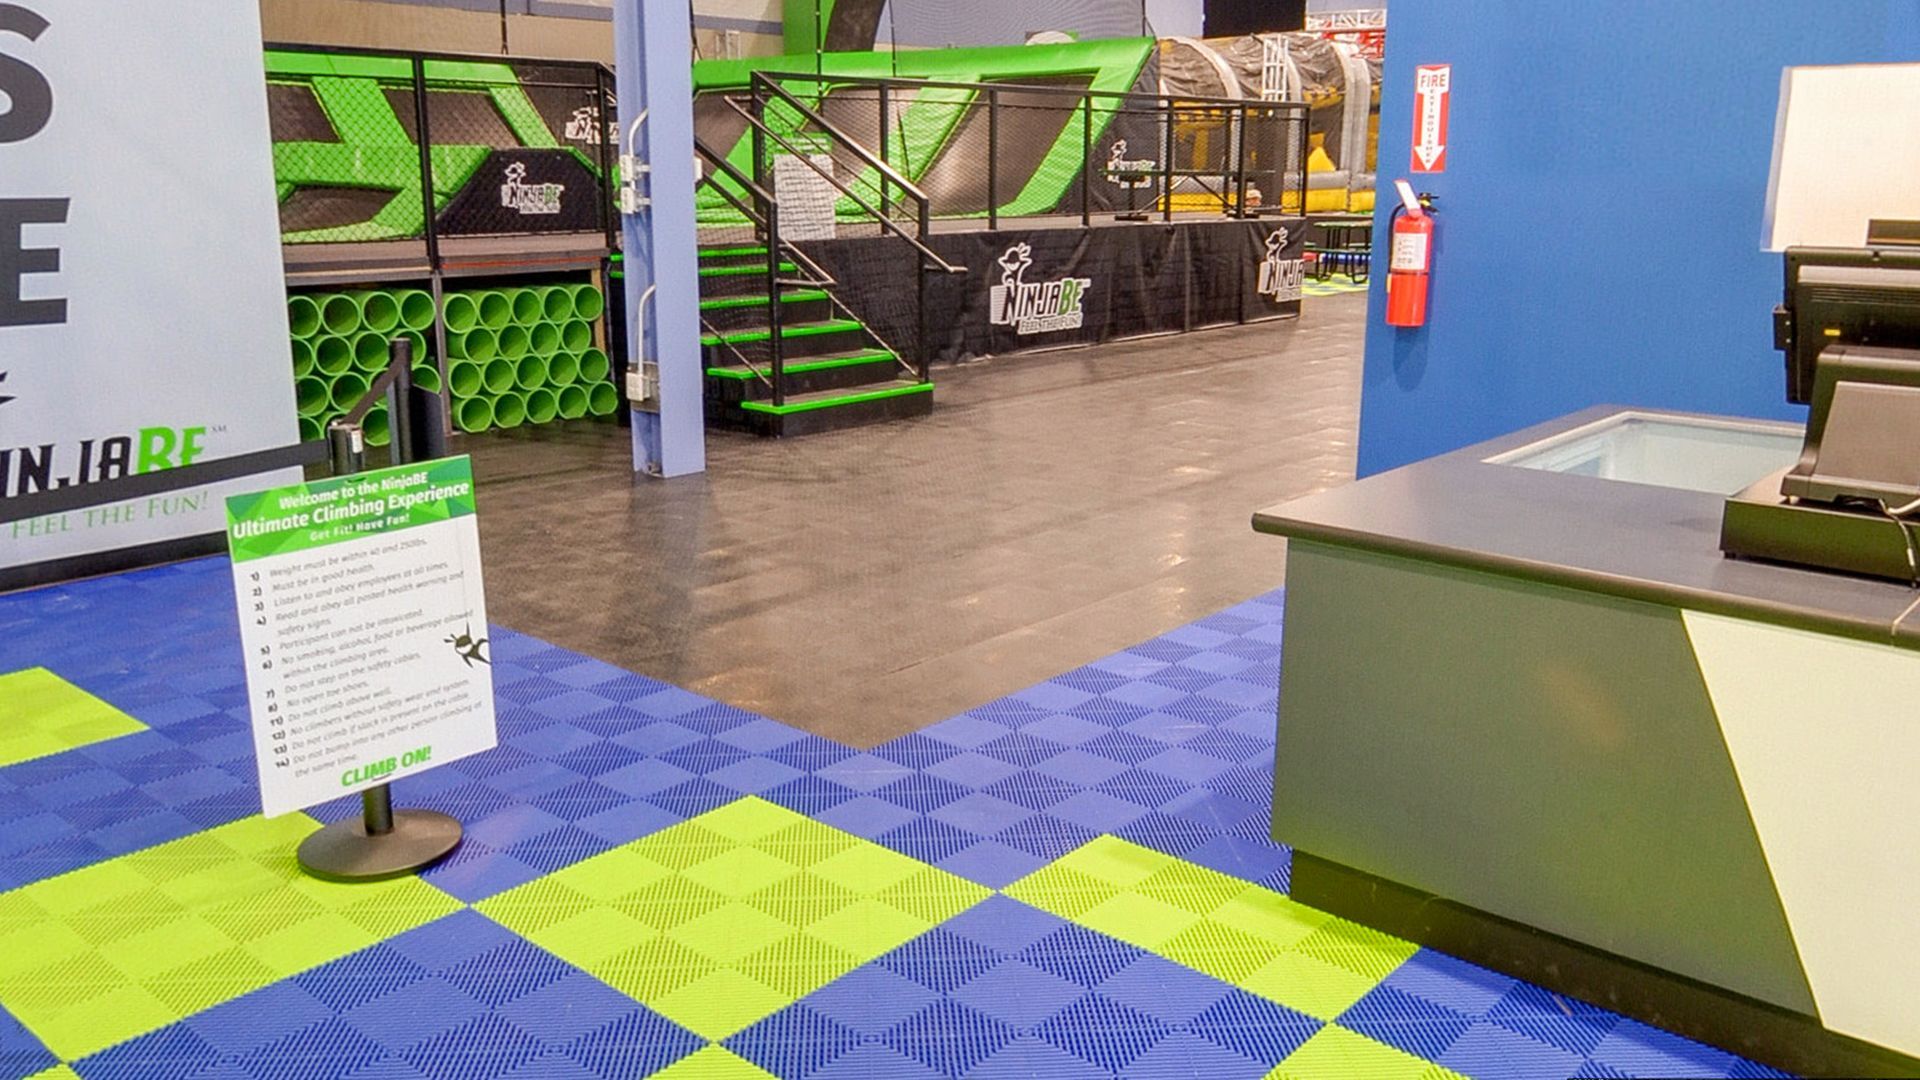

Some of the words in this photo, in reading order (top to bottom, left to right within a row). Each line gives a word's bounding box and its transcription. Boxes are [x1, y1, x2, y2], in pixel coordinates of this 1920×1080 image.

[1419, 74, 1447, 88] FIRE
[1425, 88, 1435, 164] EXTINGUISHER
[232, 513, 308, 538] Ultimate
[312, 499, 384, 523] Climbing
[387, 482, 468, 509] Experience
[279, 489, 338, 508] Welcome
[340, 486, 355, 498] to
[359, 481, 378, 495] the
[381, 471, 427, 489] NinjaBE
[11, 512, 72, 539] FEEL
[83, 503, 136, 528] THE
[148, 491, 209, 519] FUN!
[309, 530, 329, 541] Get
[333, 524, 352, 535] Fit!
[355, 519, 382, 530] Have
[386, 513, 409, 525] Fun!
[341, 757, 396, 786] CLIMB
[400, 745, 431, 767] ON!
